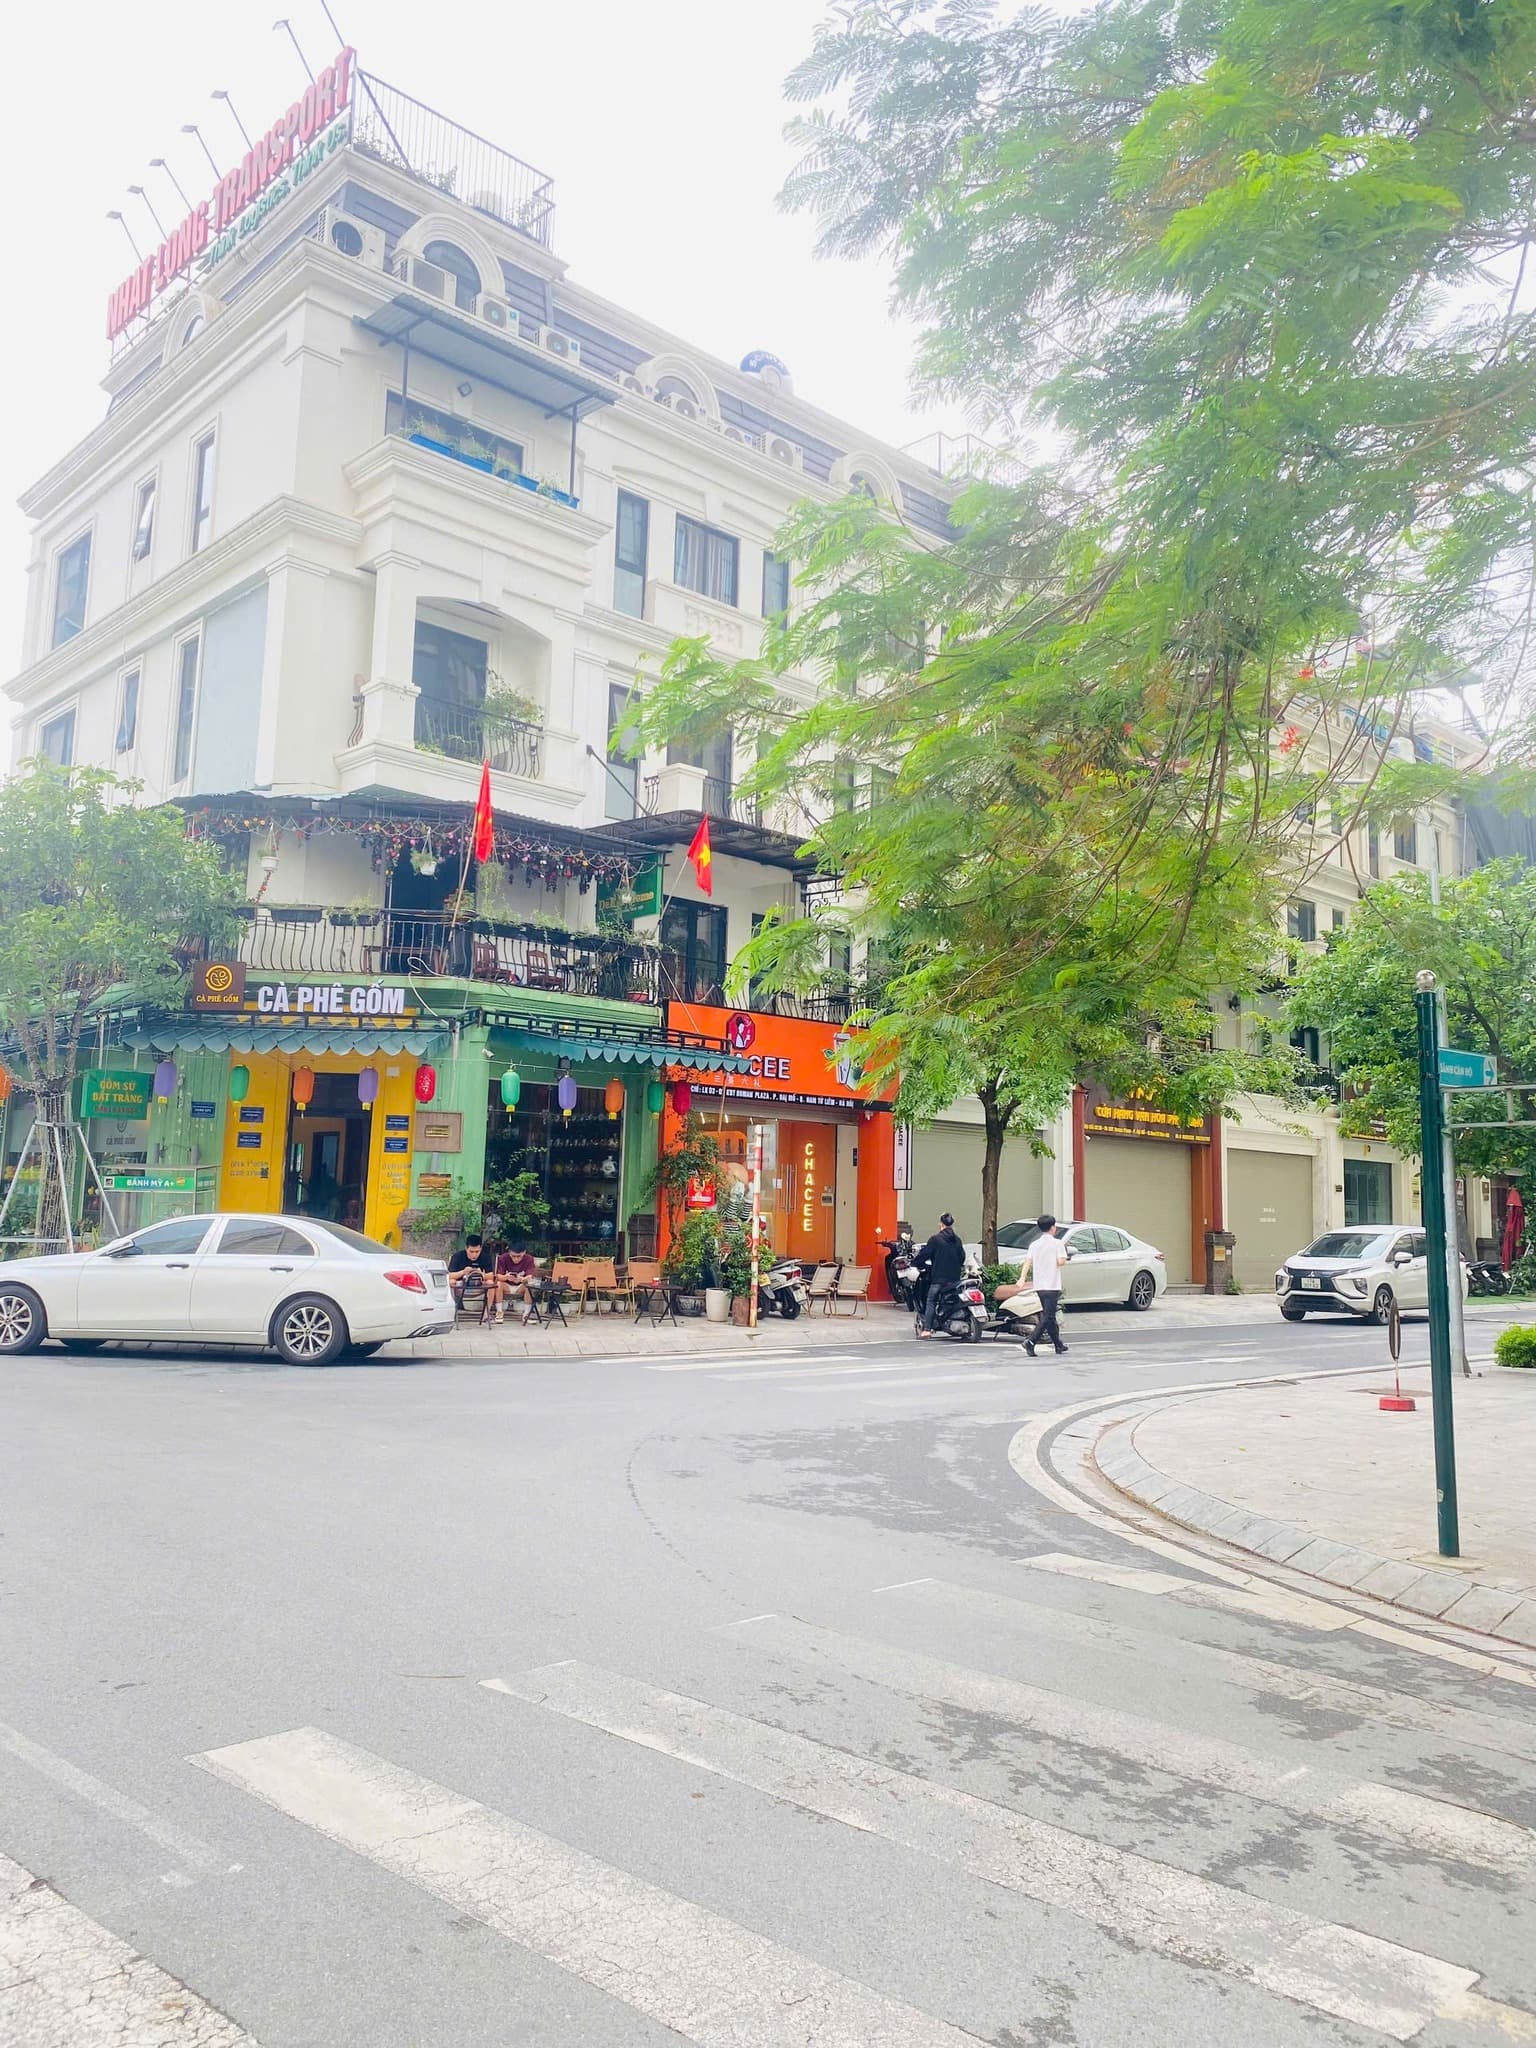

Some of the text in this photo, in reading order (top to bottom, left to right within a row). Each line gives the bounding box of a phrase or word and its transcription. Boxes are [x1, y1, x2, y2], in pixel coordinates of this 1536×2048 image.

[155, 199, 209, 294] LONG
[213, 46, 355, 233] TRANSPORT
[196, 993, 239, 1003] CÀ PHÊ GỐM
[257, 978, 405, 1014] CÀ PHÊ GỐM
[126, 1177, 150, 1187] BÁNH
[803, 1142, 815, 1232] CHACEE
